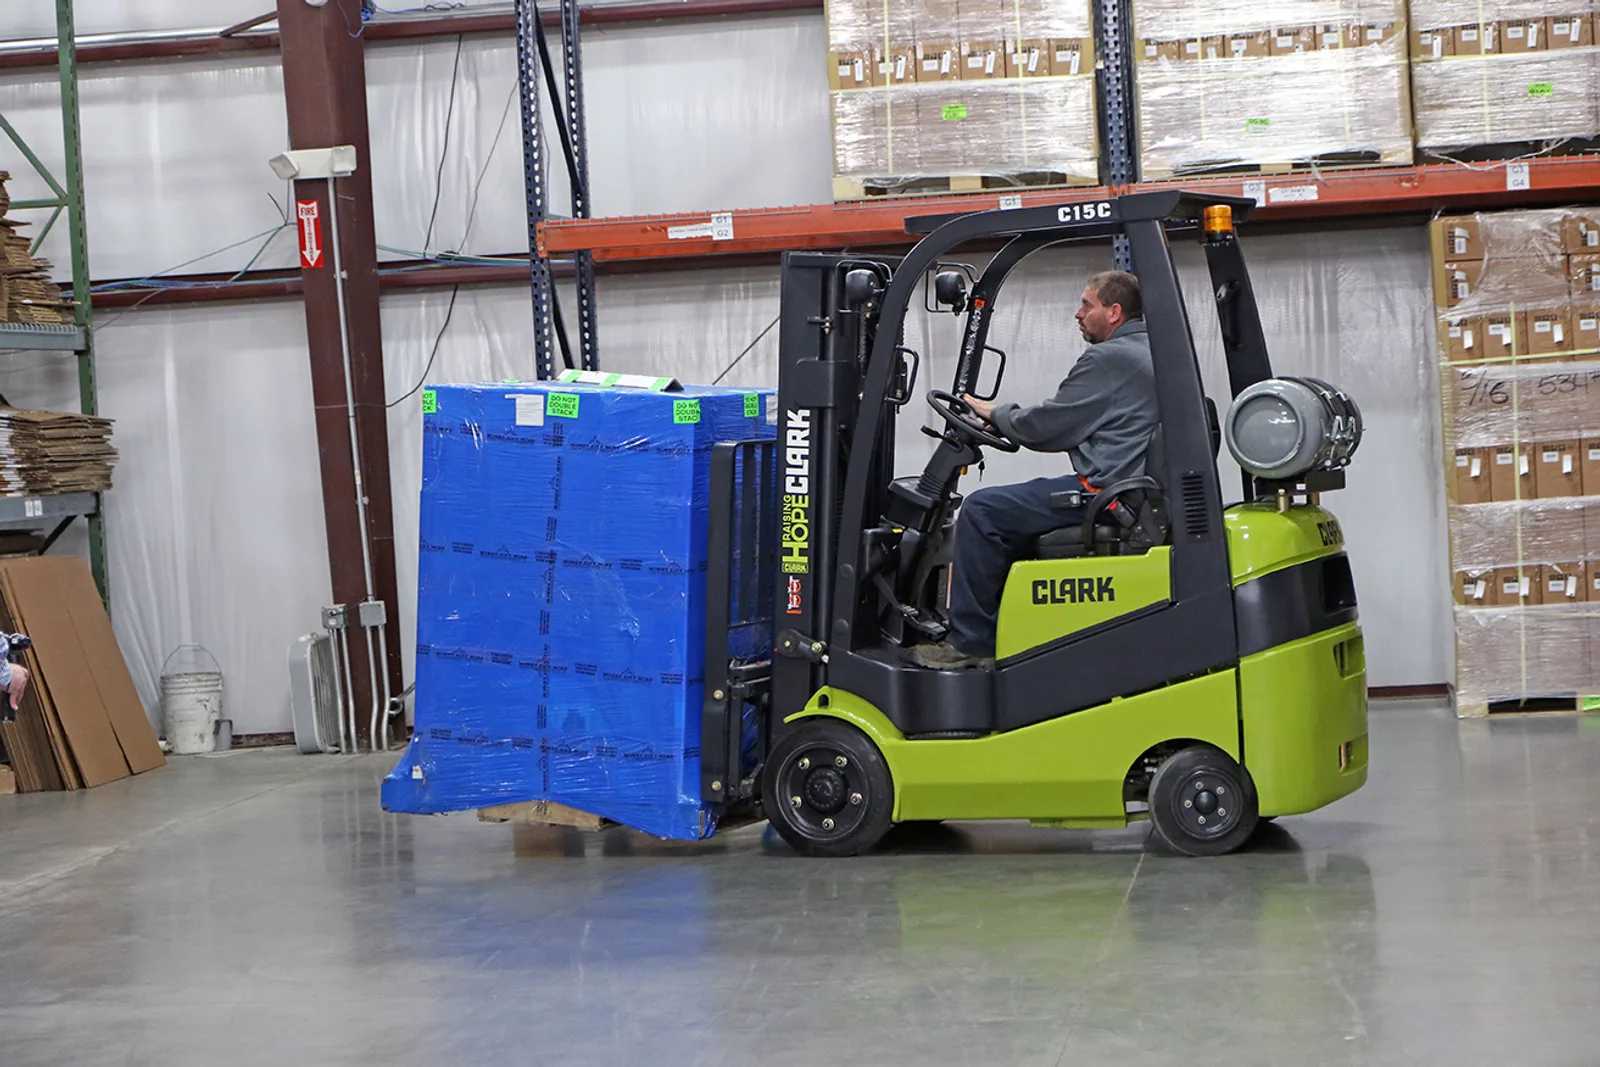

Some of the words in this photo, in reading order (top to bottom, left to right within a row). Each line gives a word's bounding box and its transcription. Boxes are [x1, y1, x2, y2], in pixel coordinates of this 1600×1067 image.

[300, 207, 316, 216] FIRE
[1057, 202, 1112, 222] C15C
[717, 229, 729, 238] G2
[549, 401, 577, 410] DOUBLE
[551, 408, 574, 416] STACK
[786, 409, 811, 494] CLARK
[783, 494, 792, 541] RAISING
[782, 495, 809, 563] HOPE
[1032, 576, 1115, 605] CLARK
